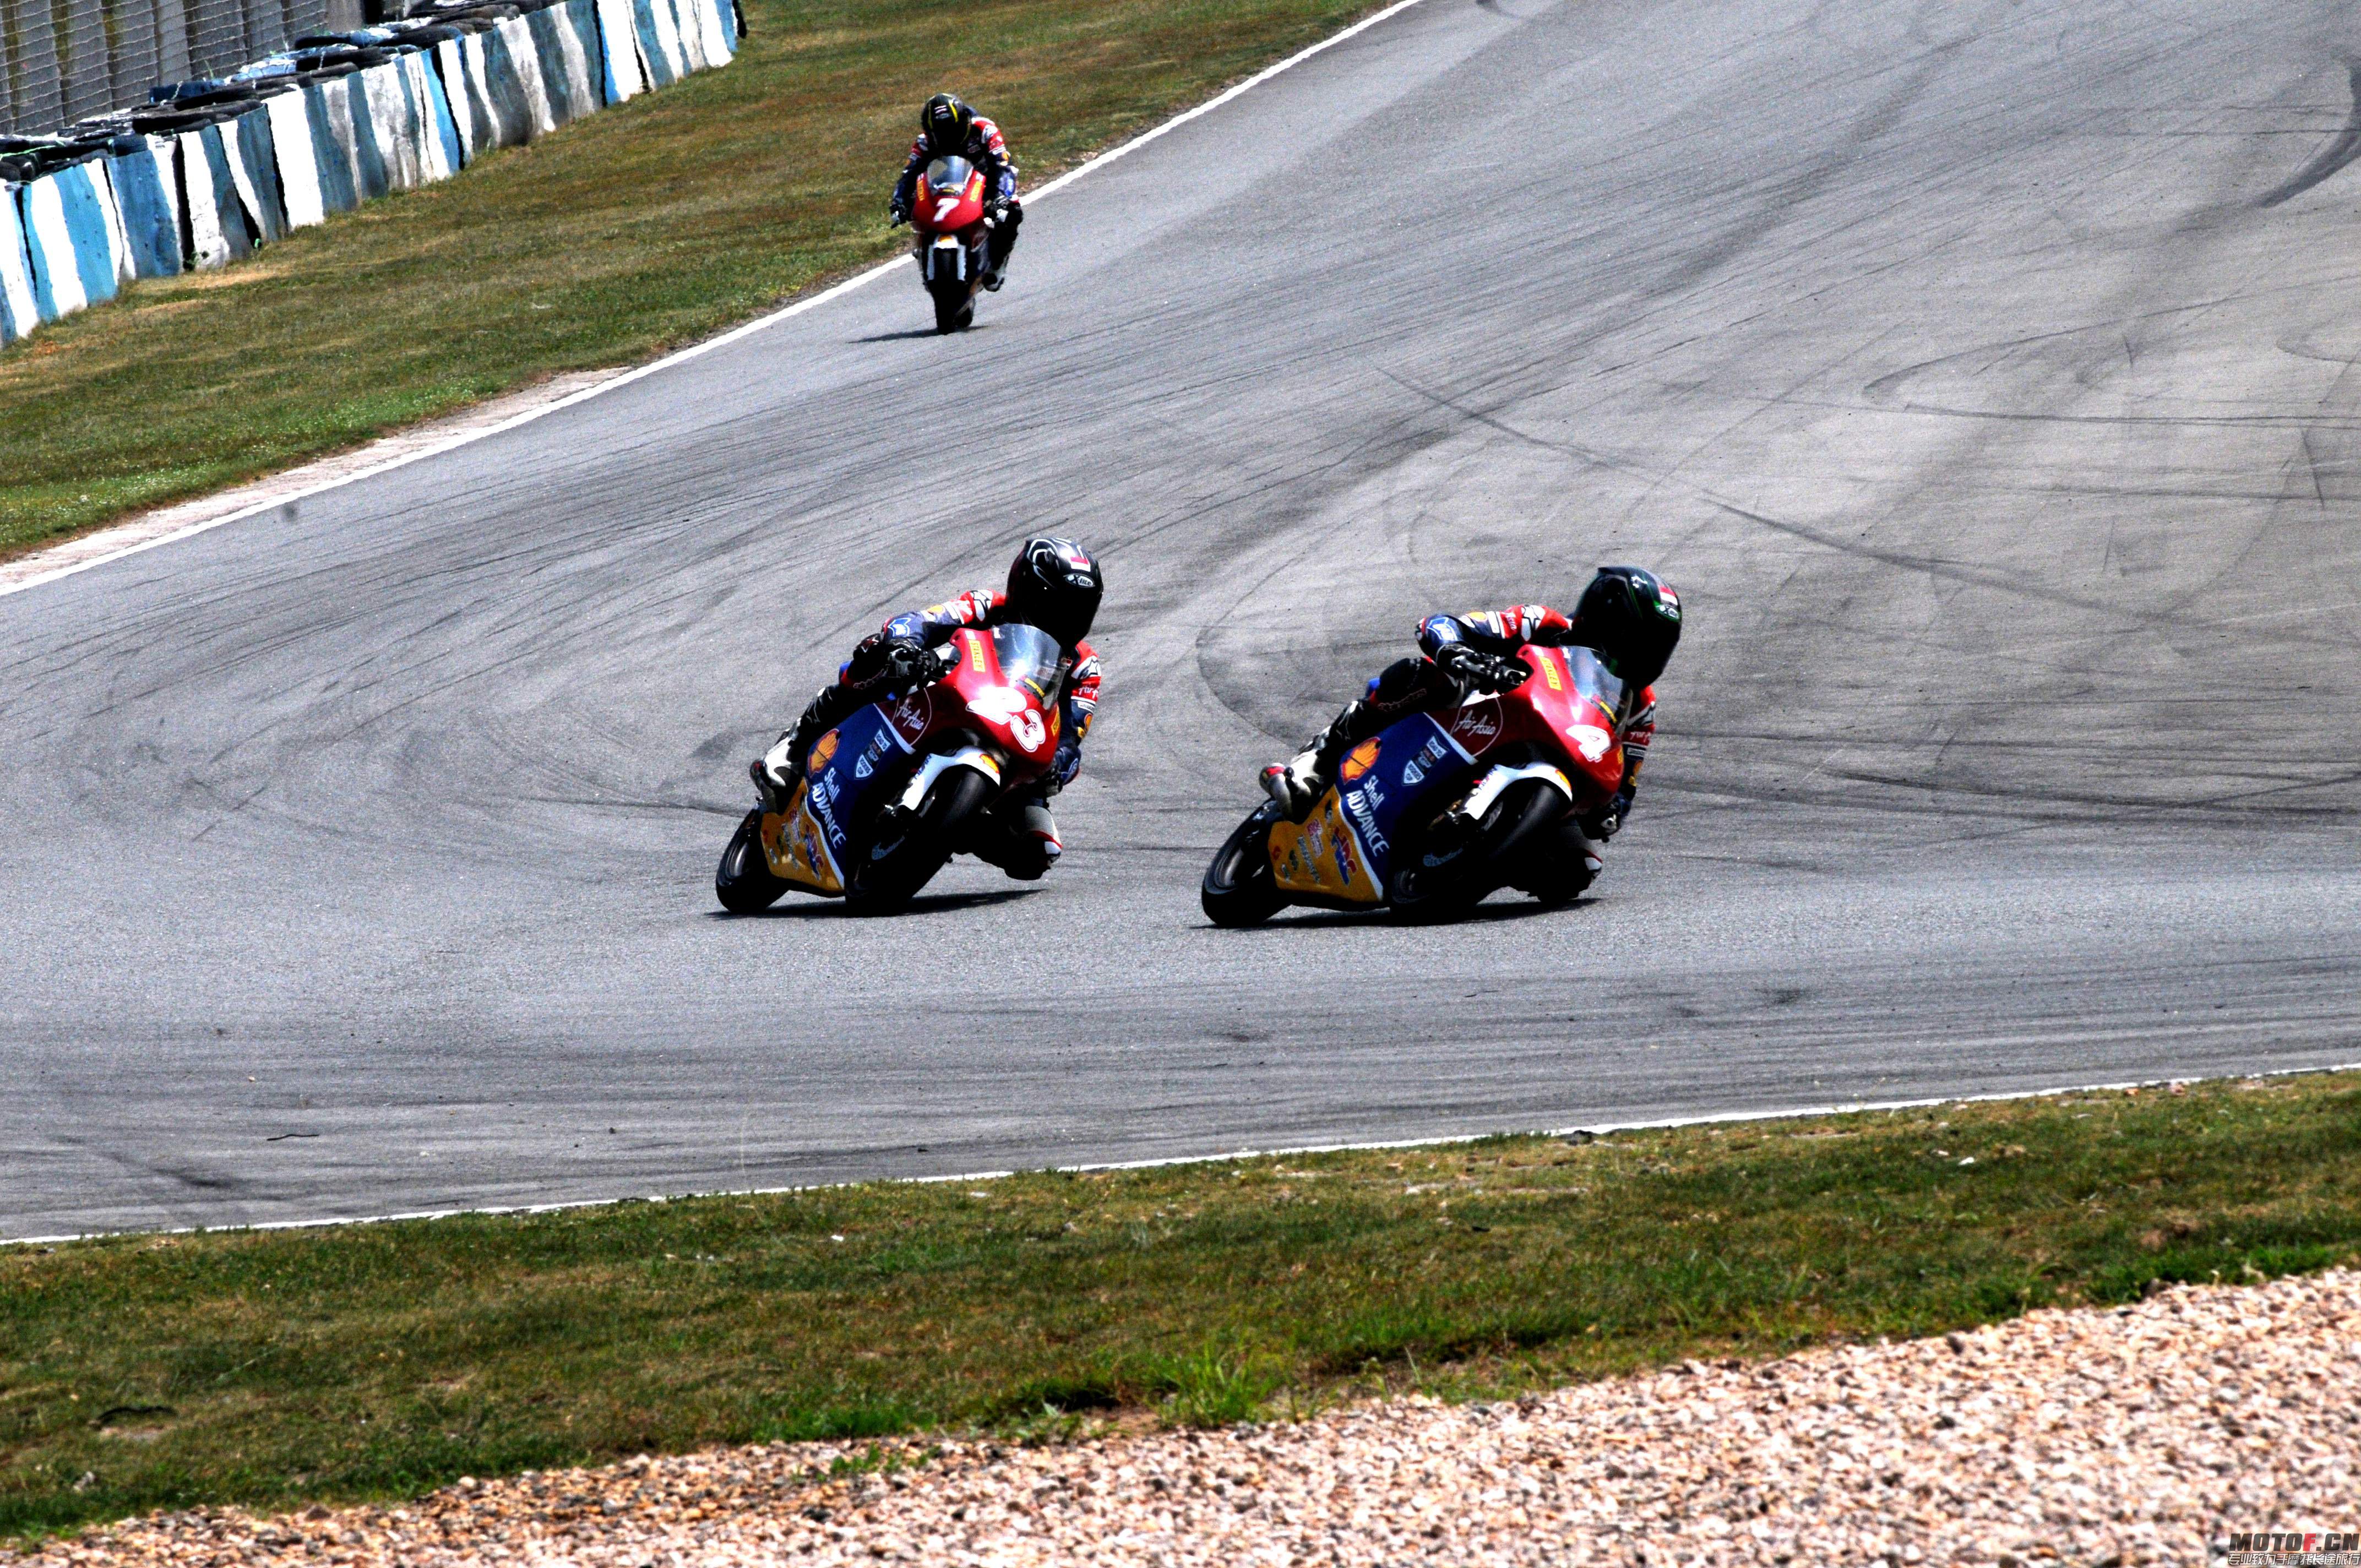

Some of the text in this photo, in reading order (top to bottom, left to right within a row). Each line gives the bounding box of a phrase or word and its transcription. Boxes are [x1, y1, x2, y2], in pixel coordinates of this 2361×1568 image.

[933, 198, 960, 222] 7
[1565, 724, 1611, 763] 4
[824, 767, 840, 804] Shell
[1364, 775, 1384, 810] Shell
[812, 782, 846, 849] ADVANCE
[1346, 790, 1390, 857] ADVANCE
